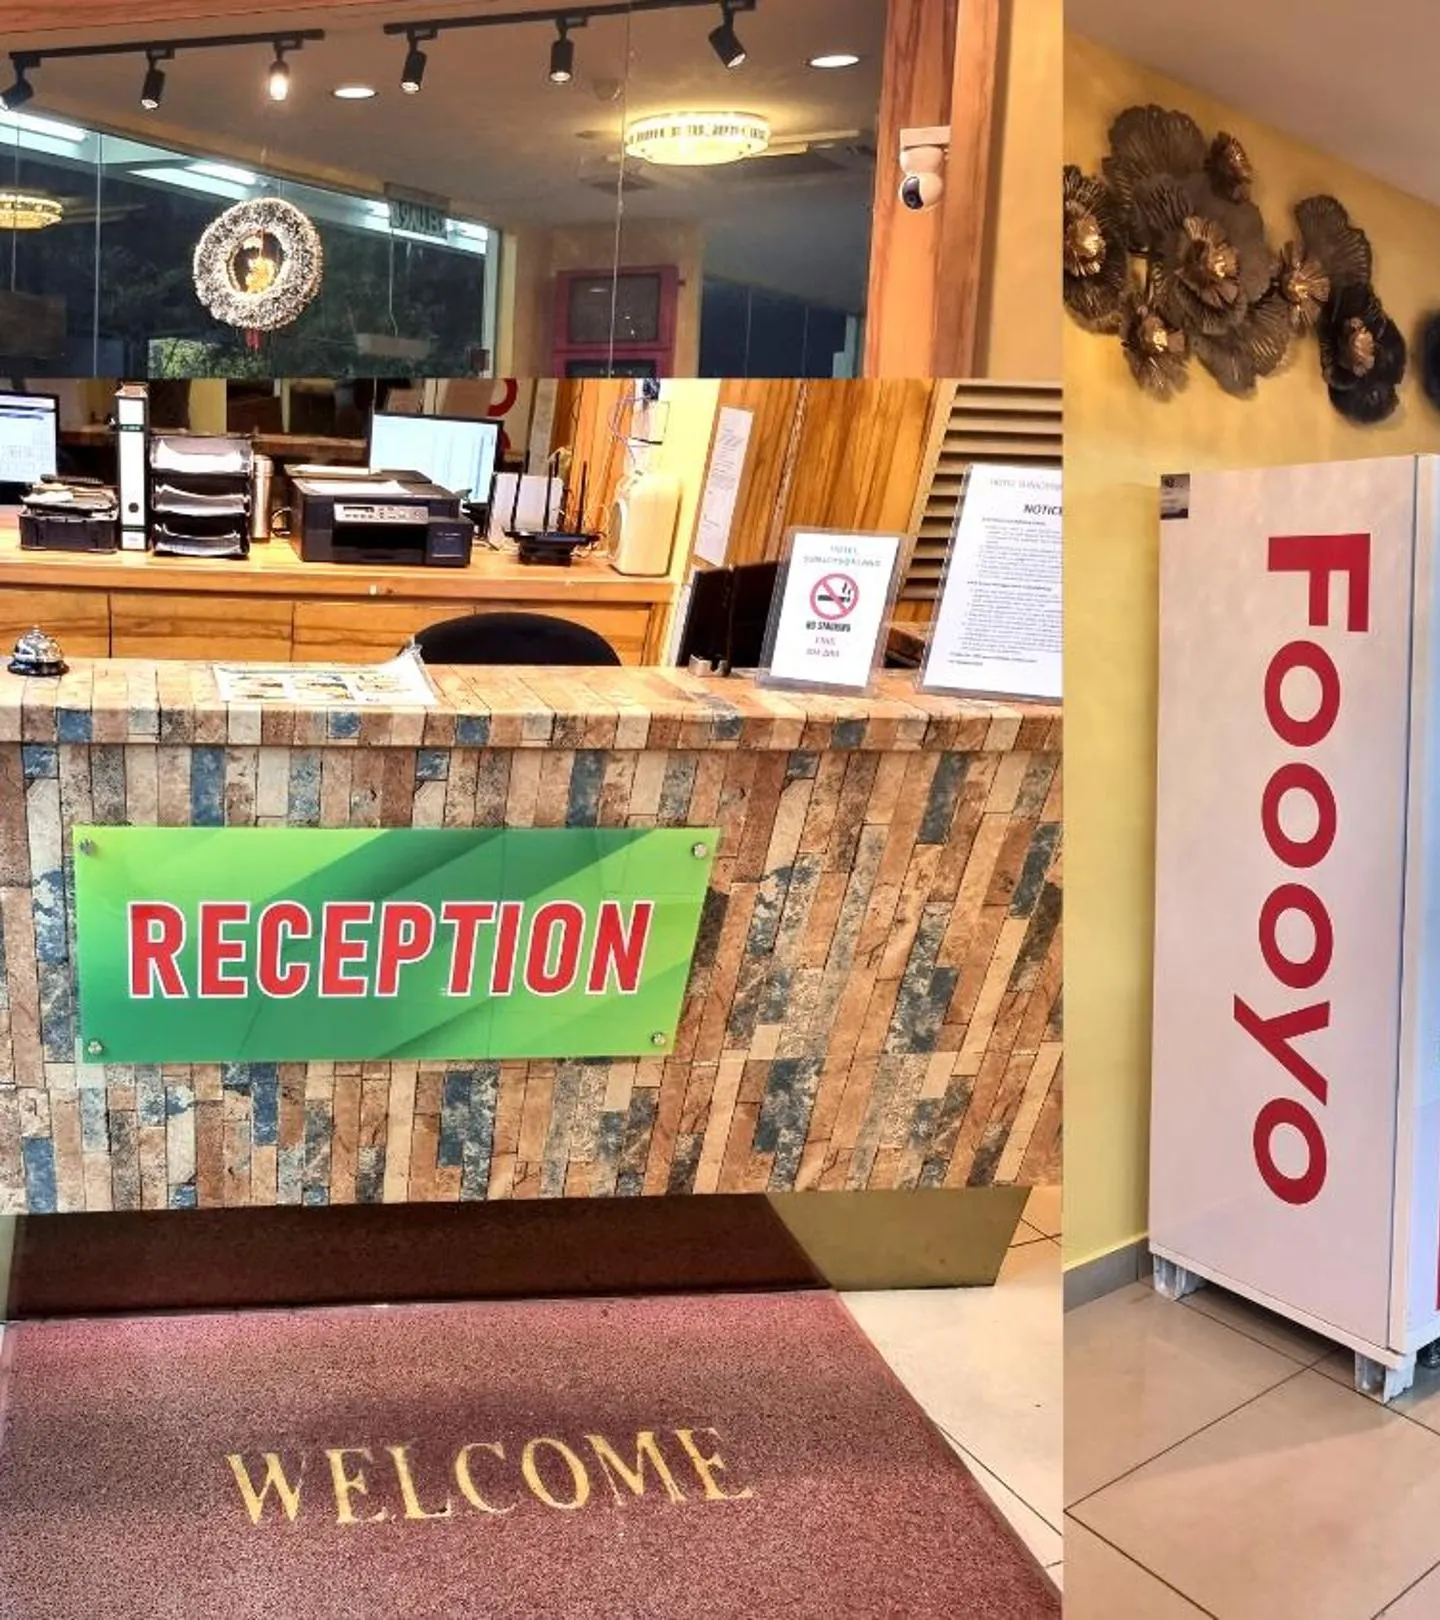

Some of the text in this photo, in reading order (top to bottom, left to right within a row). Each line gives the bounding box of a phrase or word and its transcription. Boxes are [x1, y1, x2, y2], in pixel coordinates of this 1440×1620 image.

[1234, 533, 1371, 1205] Foooyo
[127, 900, 655, 999] RECEPTION
[226, 1427, 755, 1525] WELCOME
